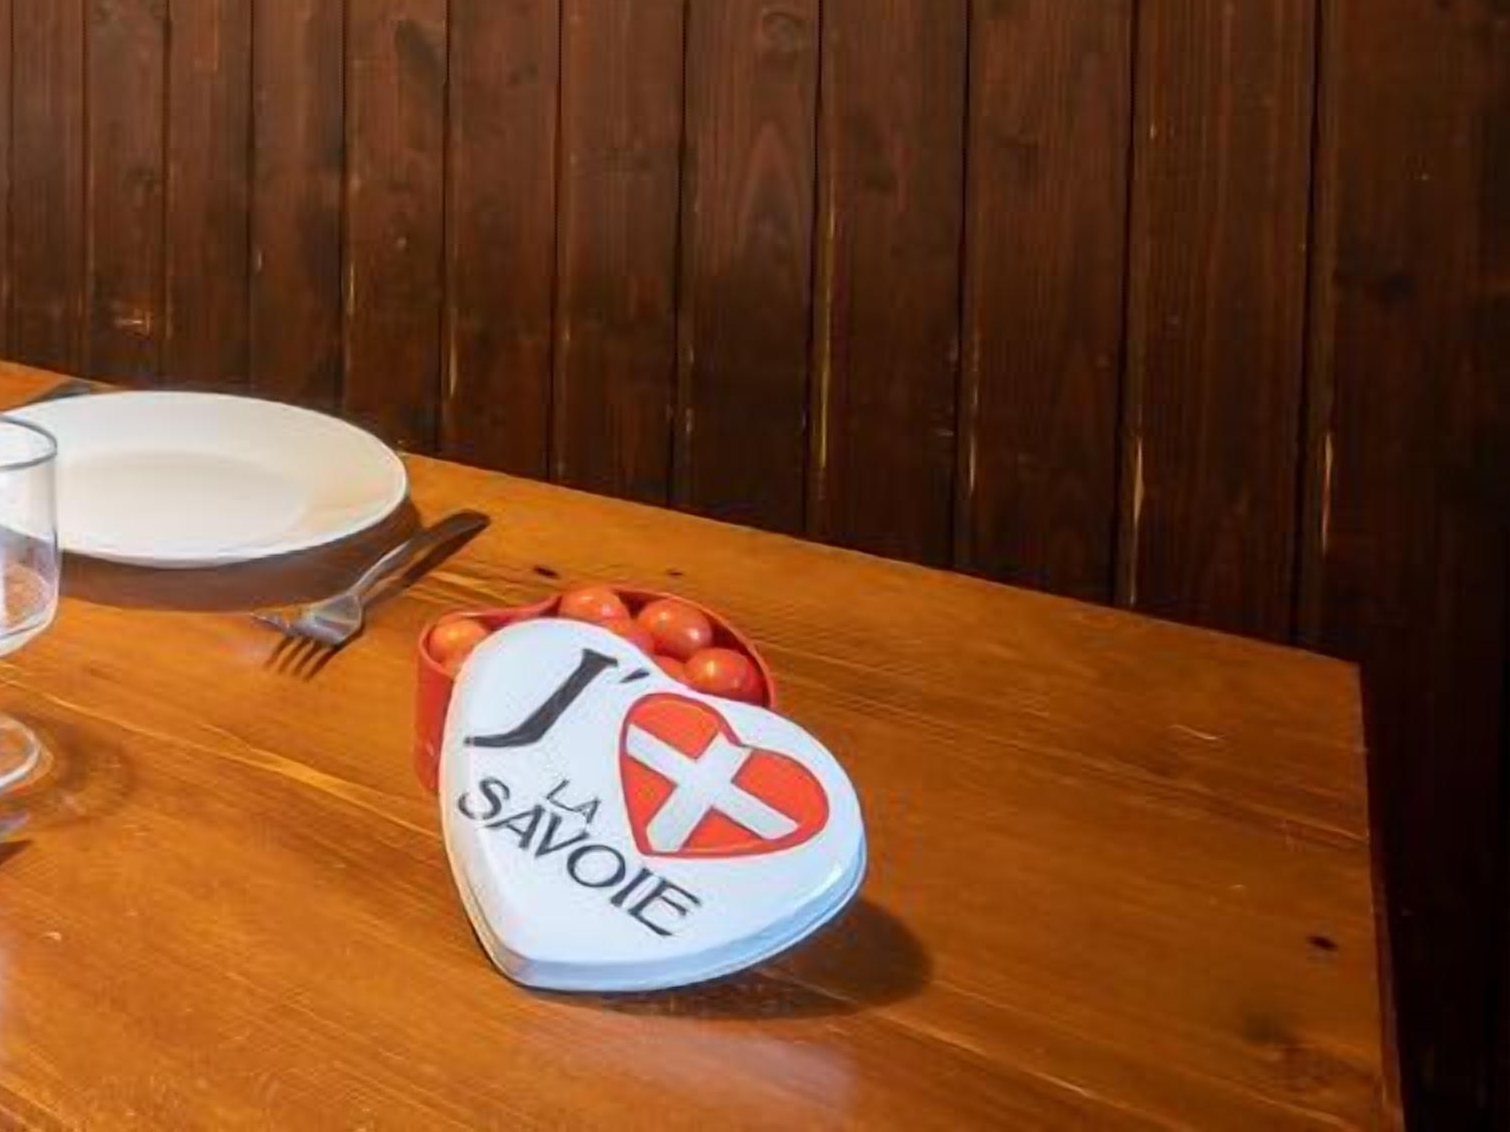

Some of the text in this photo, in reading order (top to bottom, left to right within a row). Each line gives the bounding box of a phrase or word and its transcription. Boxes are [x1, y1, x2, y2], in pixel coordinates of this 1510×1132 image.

[464, 648, 650, 748] J'
[546, 779, 602, 824] LA
[457, 776, 702, 936] SAVOIE
